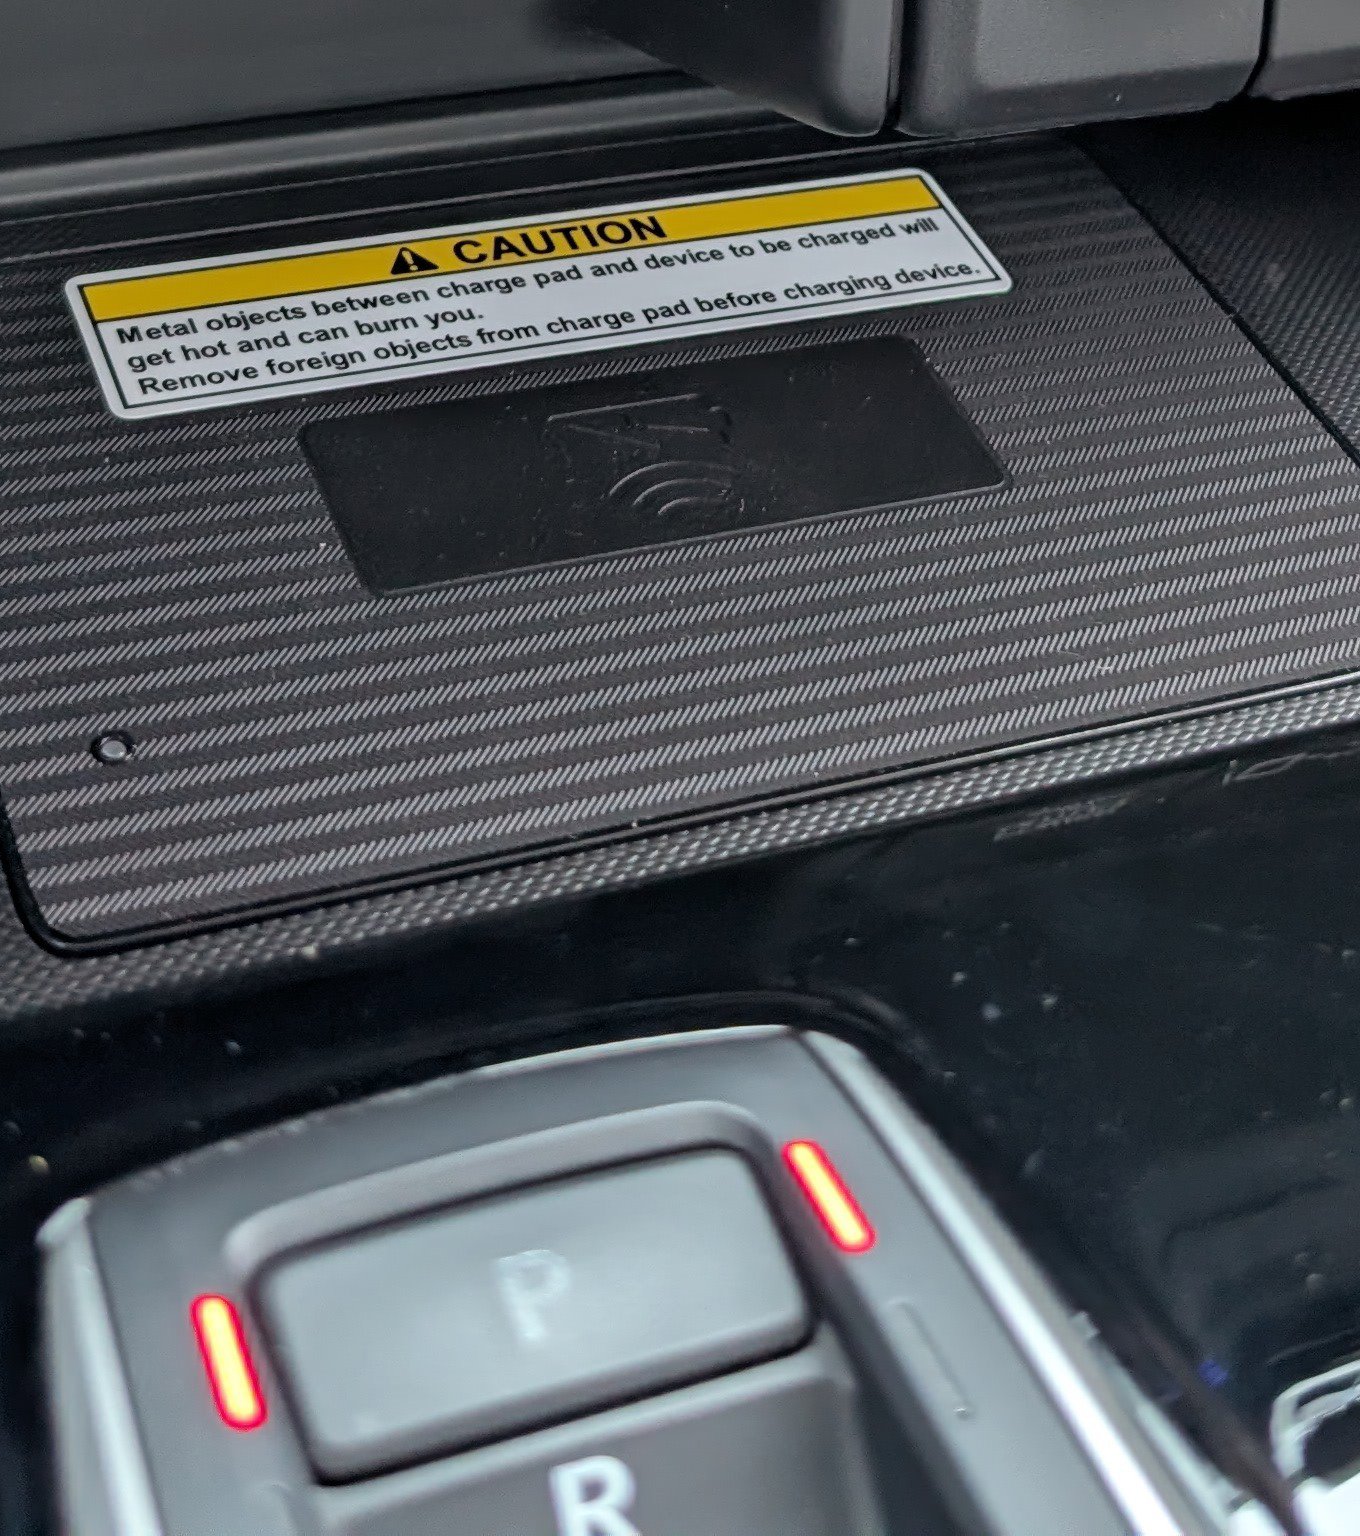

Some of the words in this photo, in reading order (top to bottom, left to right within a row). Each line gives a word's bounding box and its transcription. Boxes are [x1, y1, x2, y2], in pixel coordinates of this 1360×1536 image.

[115, 317, 199, 345] Metal
[205, 304, 307, 332] objects
[309, 289, 430, 317] between
[436, 275, 527, 300] charge
[532, 263, 583, 290] pad
[589, 257, 638, 277] and
[644, 249, 725, 270] device
[728, 243, 755, 258] to
[758, 239, 792, 254] be
[797, 222, 896, 249] charged
[899, 217, 939, 235] will
[452, 215, 668, 264] CAUTION
[127, 348, 176, 374] get
[180, 340, 231, 361] hot
[237, 330, 291, 353] and
[298, 326, 350, 344] can
[353, 316, 419, 337] burn
[423, 308, 485, 331] you.
[138, 366, 260, 396] Remove
[265, 350, 367, 375] foreign
[373, 333, 473, 361] objects
[476, 325, 540, 345] from
[546, 311, 636, 336] charge
[641, 299, 691, 324] pad
[694, 291, 777, 313] before
[783, 274, 892, 303] charging
[895, 264, 982, 286] device.
[495, 1250, 571, 1342] P
[551, 1455, 640, 1536] R
